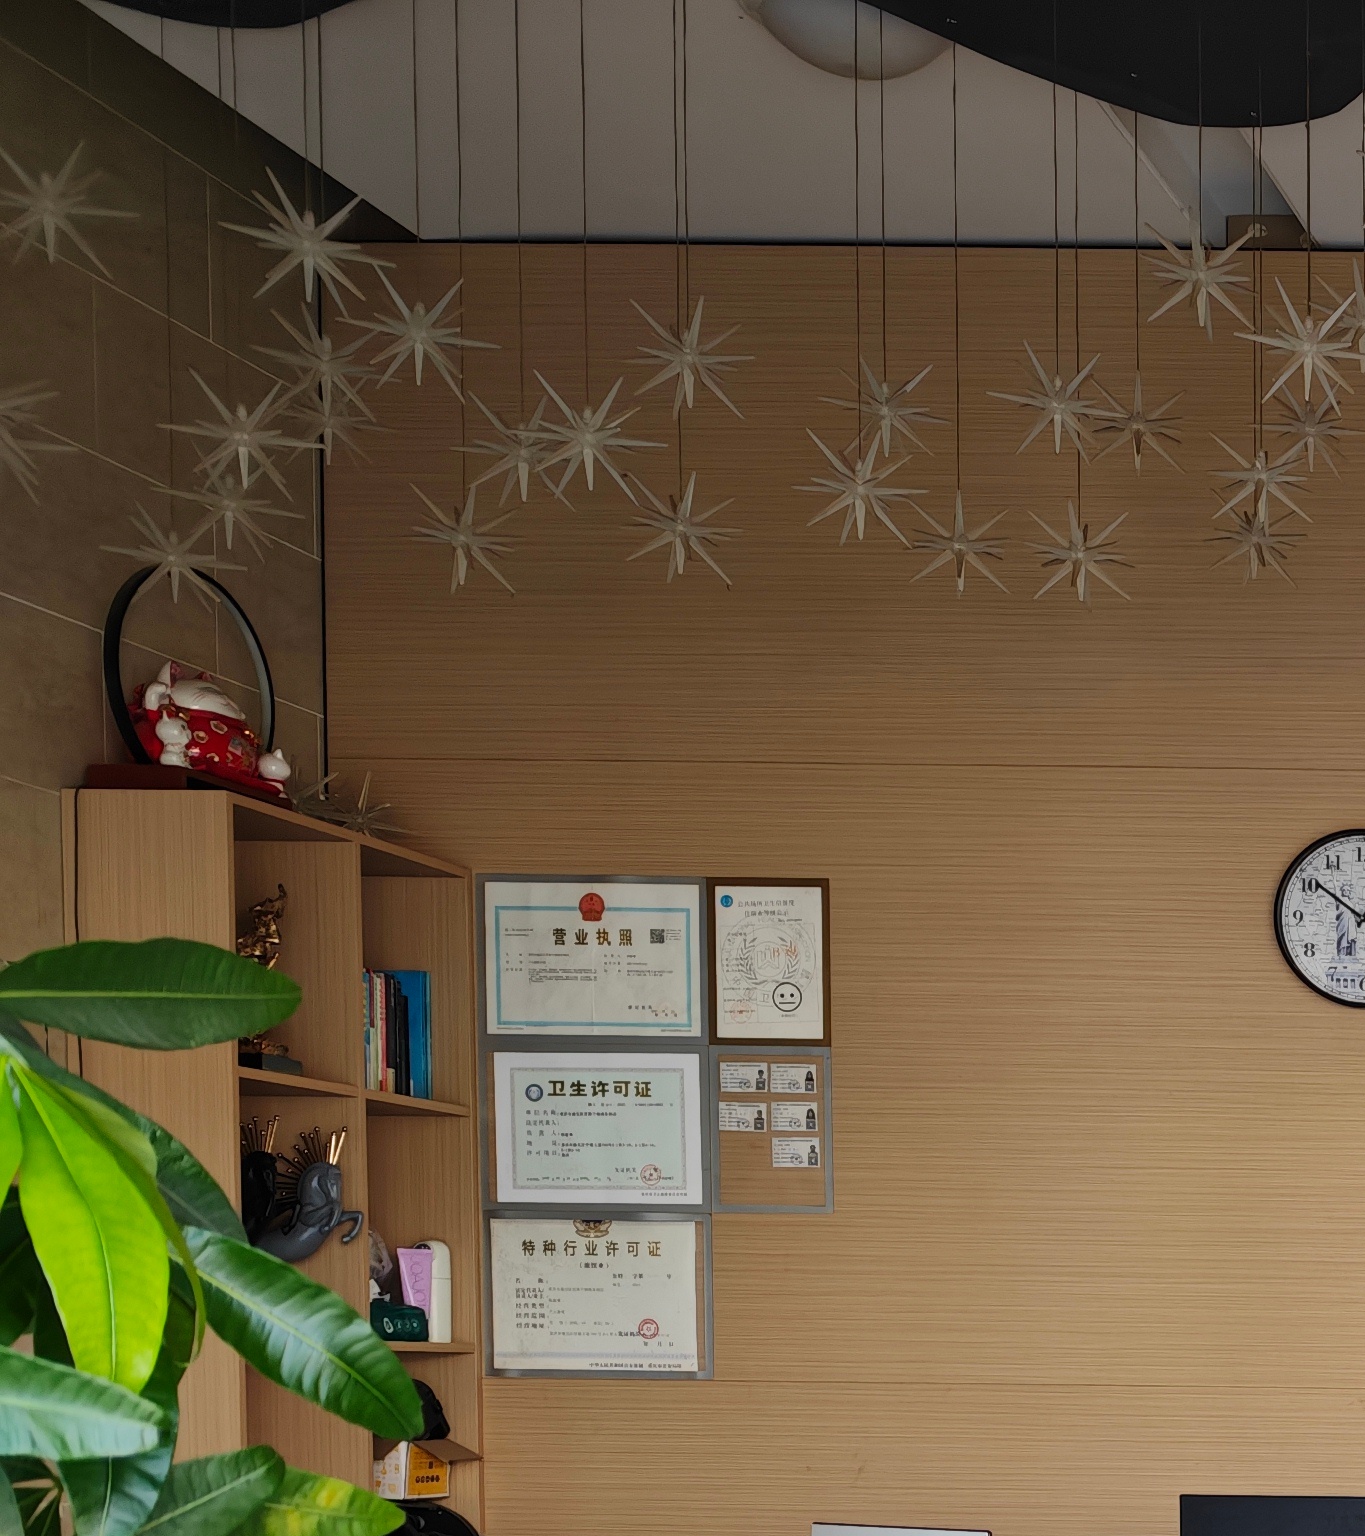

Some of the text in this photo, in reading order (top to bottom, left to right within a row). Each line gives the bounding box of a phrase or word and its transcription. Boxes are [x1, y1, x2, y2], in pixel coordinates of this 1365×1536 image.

[1325, 855, 1342, 870] 11
[1301, 878, 1320, 893] 10
[1293, 909, 1304, 926] 9
[552, 928, 633, 946] 营业执照
[1304, 942, 1315, 957] 8
[1327, 966, 1338, 982] 7
[547, 1080, 652, 1098] 卫生许可证
[521, 1239, 662, 1258] 特种行业许可证
